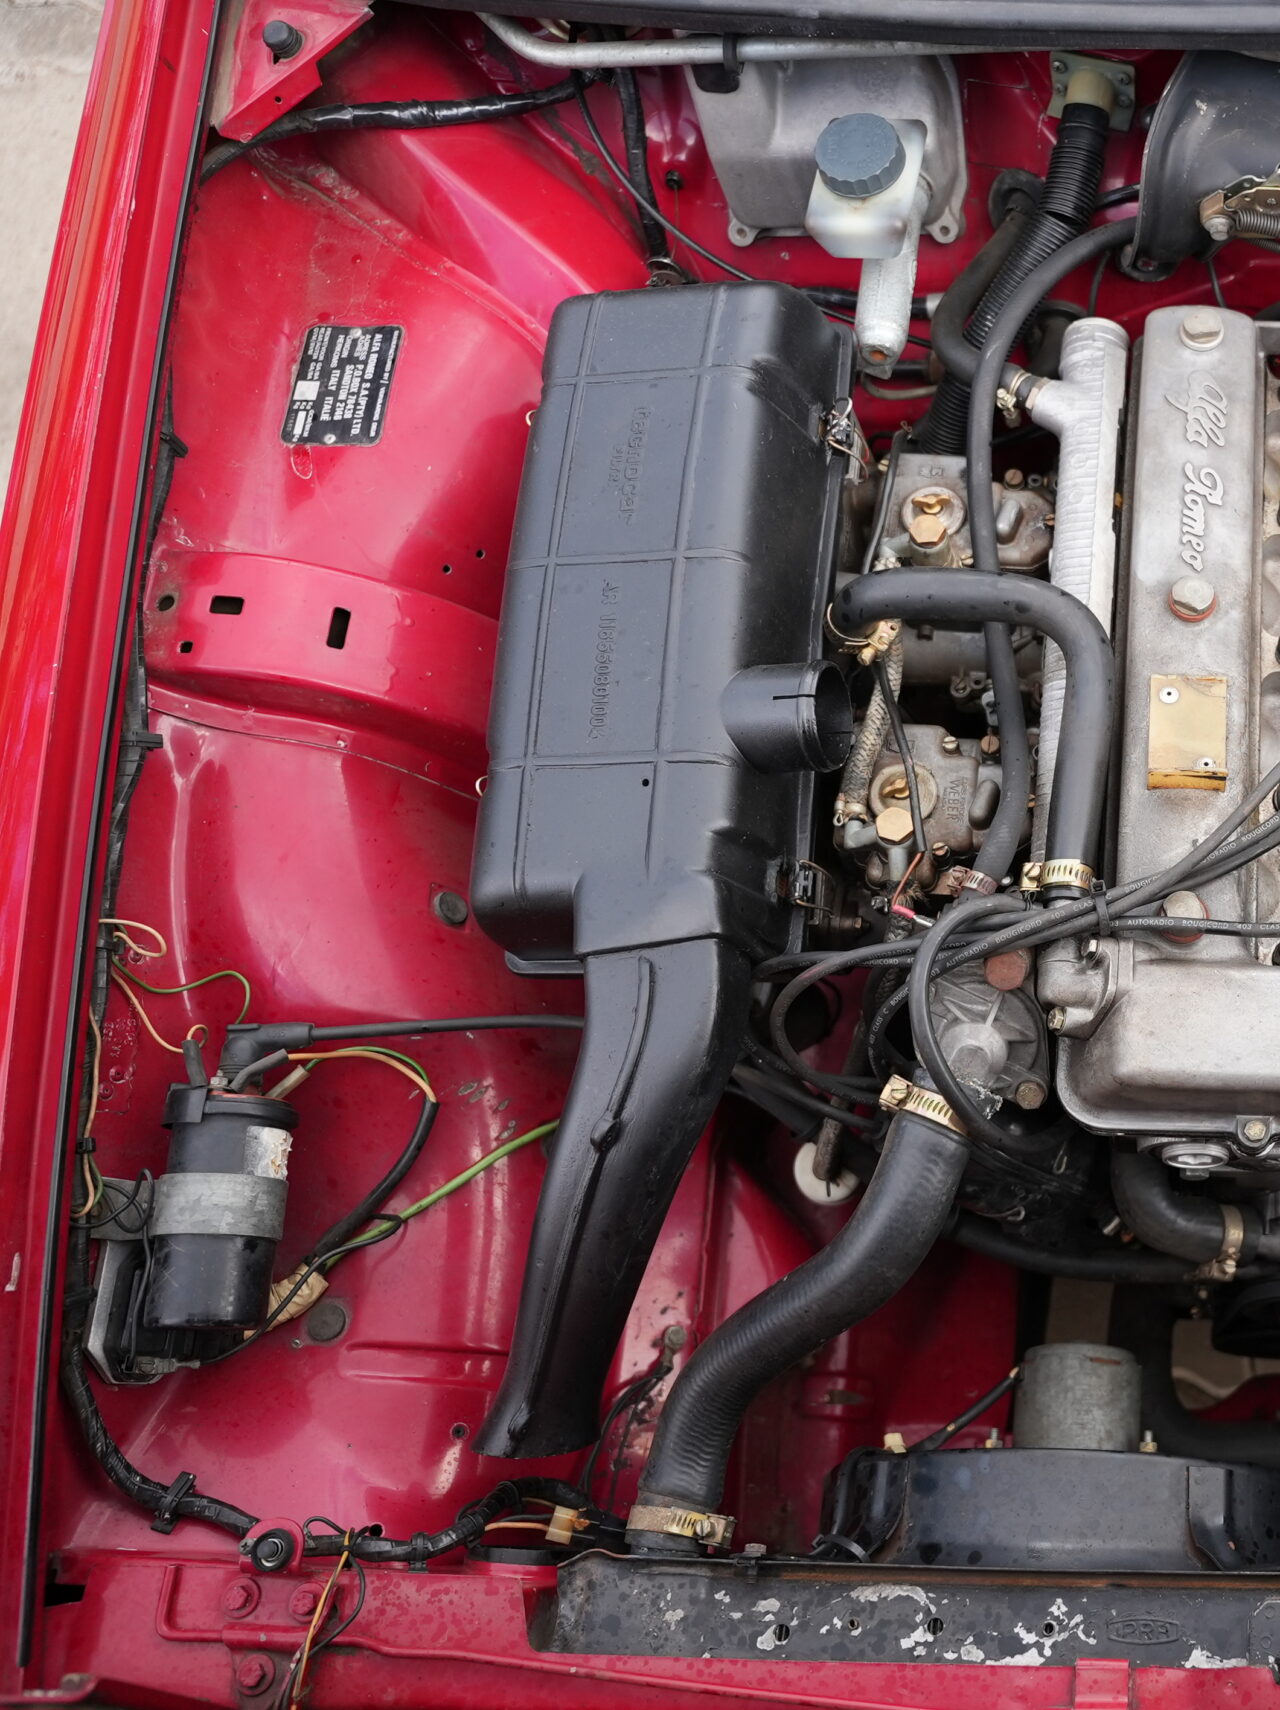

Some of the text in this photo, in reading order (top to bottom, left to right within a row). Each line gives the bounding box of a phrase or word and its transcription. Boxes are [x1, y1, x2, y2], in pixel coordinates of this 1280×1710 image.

[371, 333, 383, 352] ALFA
[364, 353, 378, 379] ROMEO
[328, 370, 340, 390] ITALY
[338, 365, 354, 400] SANDTON
[350, 419, 361, 436] LTD.
[1164, 370, 1227, 572] Alfa Romeo
[946, 780, 960, 822] WEBER
[1242, 815, 1280, 841] BOUGICORD
[945, 942, 989, 968] AUTORADIO
[995, 919, 1043, 944] BOUGICORD
[1051, 910, 1066, 920] 403
[1072, 900, 1094, 912] CLAS
[1182, 920, 1229, 929] BOUGICORD
